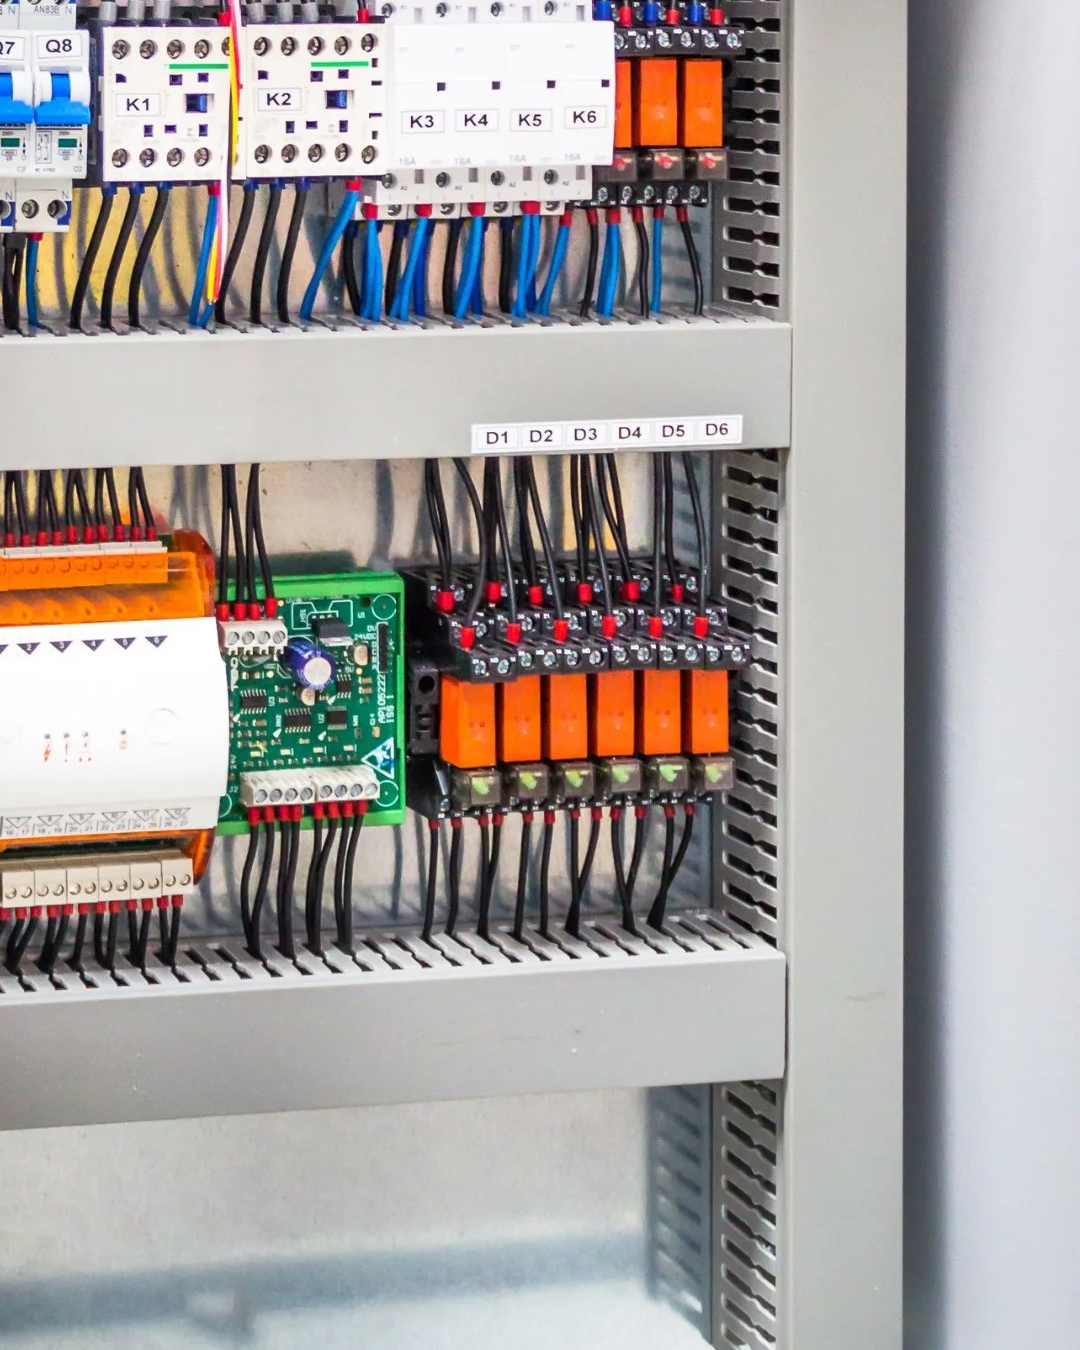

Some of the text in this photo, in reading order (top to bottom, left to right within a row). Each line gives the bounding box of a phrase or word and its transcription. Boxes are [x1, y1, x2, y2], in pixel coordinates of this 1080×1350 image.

[7, 5, 16, 15] N
[64, 5, 73, 14] N
[45, 38, 73, 53] Q8
[126, 98, 150, 111] K1
[266, 92, 291, 106] K2
[410, 115, 434, 128] K3
[464, 113, 488, 127] K4
[518, 114, 542, 127] K5
[573, 110, 597, 123] K6
[5, 191, 14, 201] N
[61, 190, 70, 200] N
[486, 422, 729, 445] D1 D2 D3 D4 D5 D6
[357, 611, 366, 619] U1
[377, 674, 386, 724] AP105222
[318, 713, 325, 723] U2
[385, 705, 395, 723] ISS
